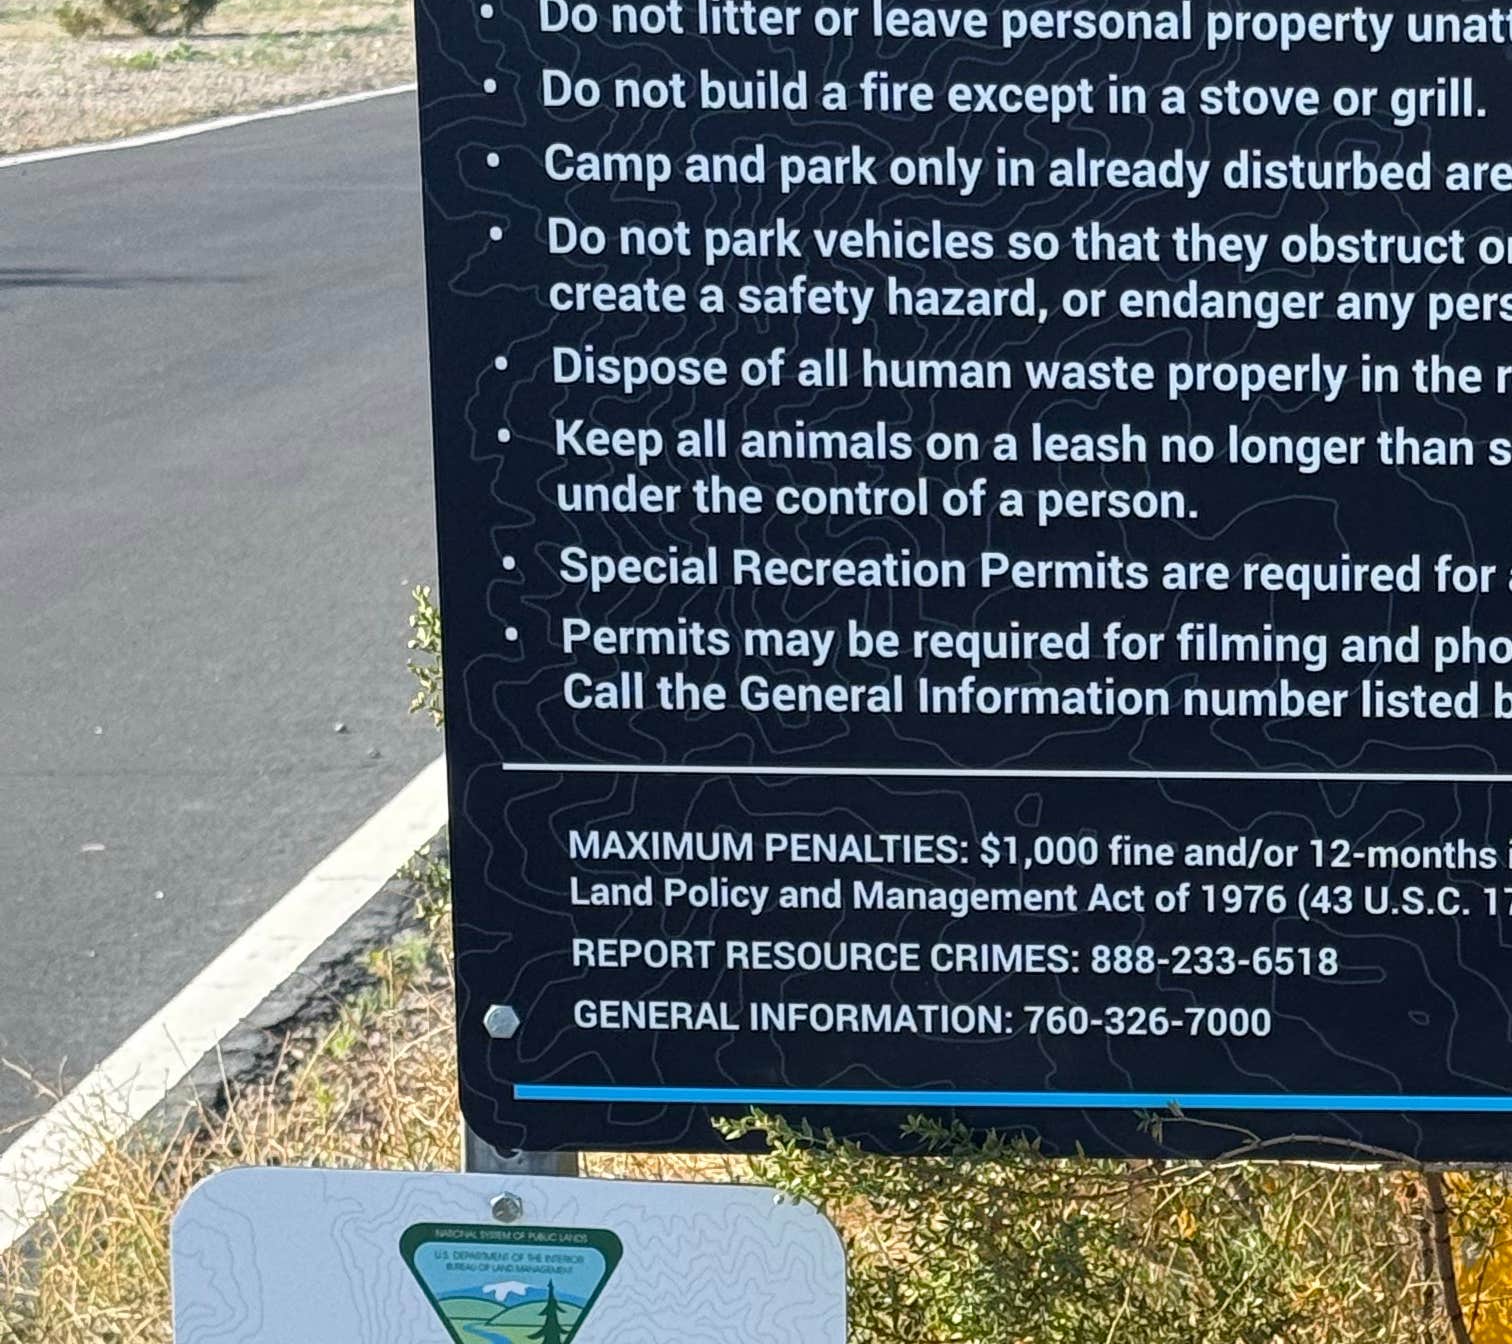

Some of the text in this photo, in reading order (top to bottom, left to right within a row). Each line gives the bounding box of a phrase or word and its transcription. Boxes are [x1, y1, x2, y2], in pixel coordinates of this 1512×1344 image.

[544, 142, 672, 193] Camp
[685, 142, 765, 184] and
[780, 144, 878, 194] park
[889, 145, 983, 197] only
[997, 145, 1035, 187] in
[1049, 146, 1211, 199] already
[1223, 148, 1431, 192] disturbed
[557, 472, 1198, 527] under the control of a person.
[563, 670, 644, 710] Call
[656, 671, 727, 712] the
[740, 674, 903, 714] General
[919, 674, 1169, 716] Information
[1184, 677, 1349, 718] number
[1362, 679, 1479, 720] listed
[570, 874, 653, 907] Land
[664, 876, 770, 916] Policy
[779, 877, 842, 909] and
[853, 879, 1078, 919] Management
[1087, 882, 1145, 913] Act
[1155, 881, 1191, 913] of
[1201, 883, 1287, 914] 1976
[1298, 882, 1353, 922] (43
[1364, 885, 1470, 916] U.S.C.
[572, 938, 1338, 977] REPORT RESOURCE CRIMES: 888-233-6518
[574, 998, 1271, 1037] GENERAL INFORMATION: 760-326-7000
